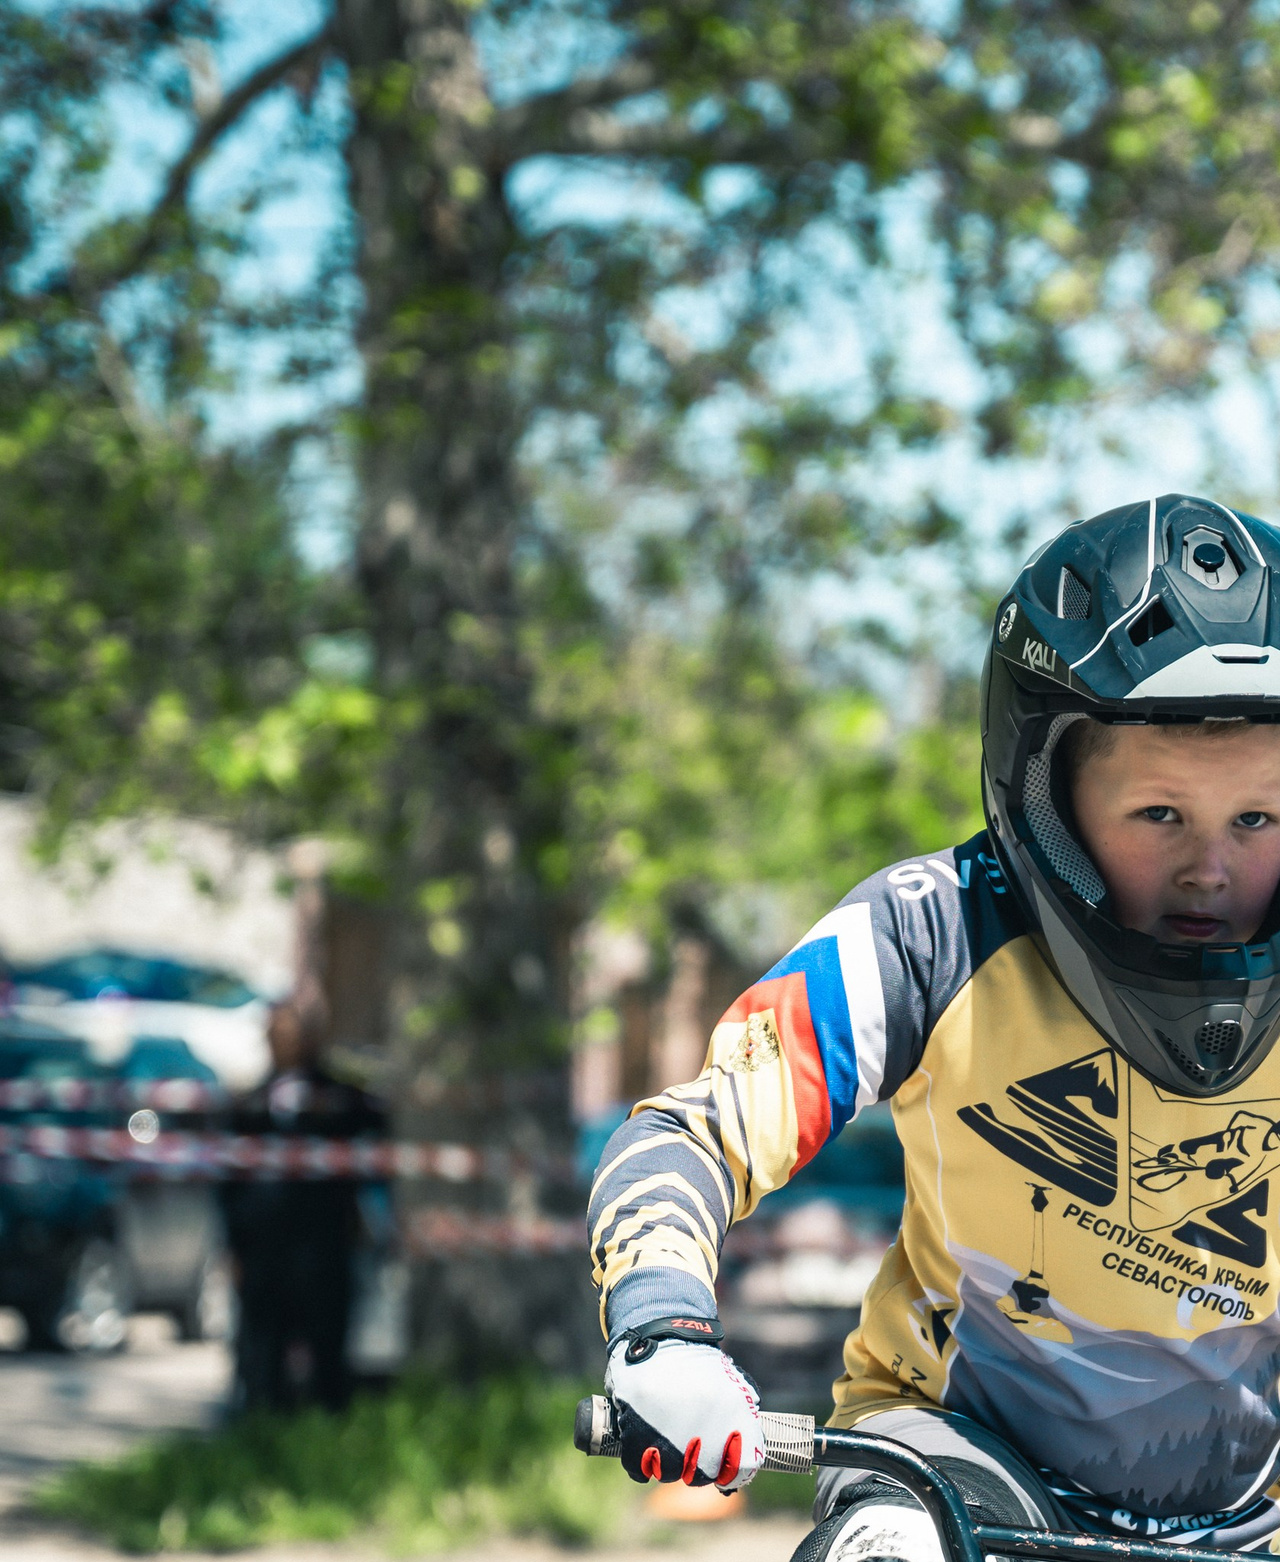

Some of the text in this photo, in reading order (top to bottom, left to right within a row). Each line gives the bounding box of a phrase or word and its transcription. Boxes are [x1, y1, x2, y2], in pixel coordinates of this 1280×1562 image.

[1022, 637, 1057, 672] KALI
[1063, 1203, 1270, 1298] РЕСПУБЛИКА КРЫМ
[1102, 1252, 1256, 1321] СЕВАСТОПОЛЬ
[671, 1318, 714, 1334] FUZZ
